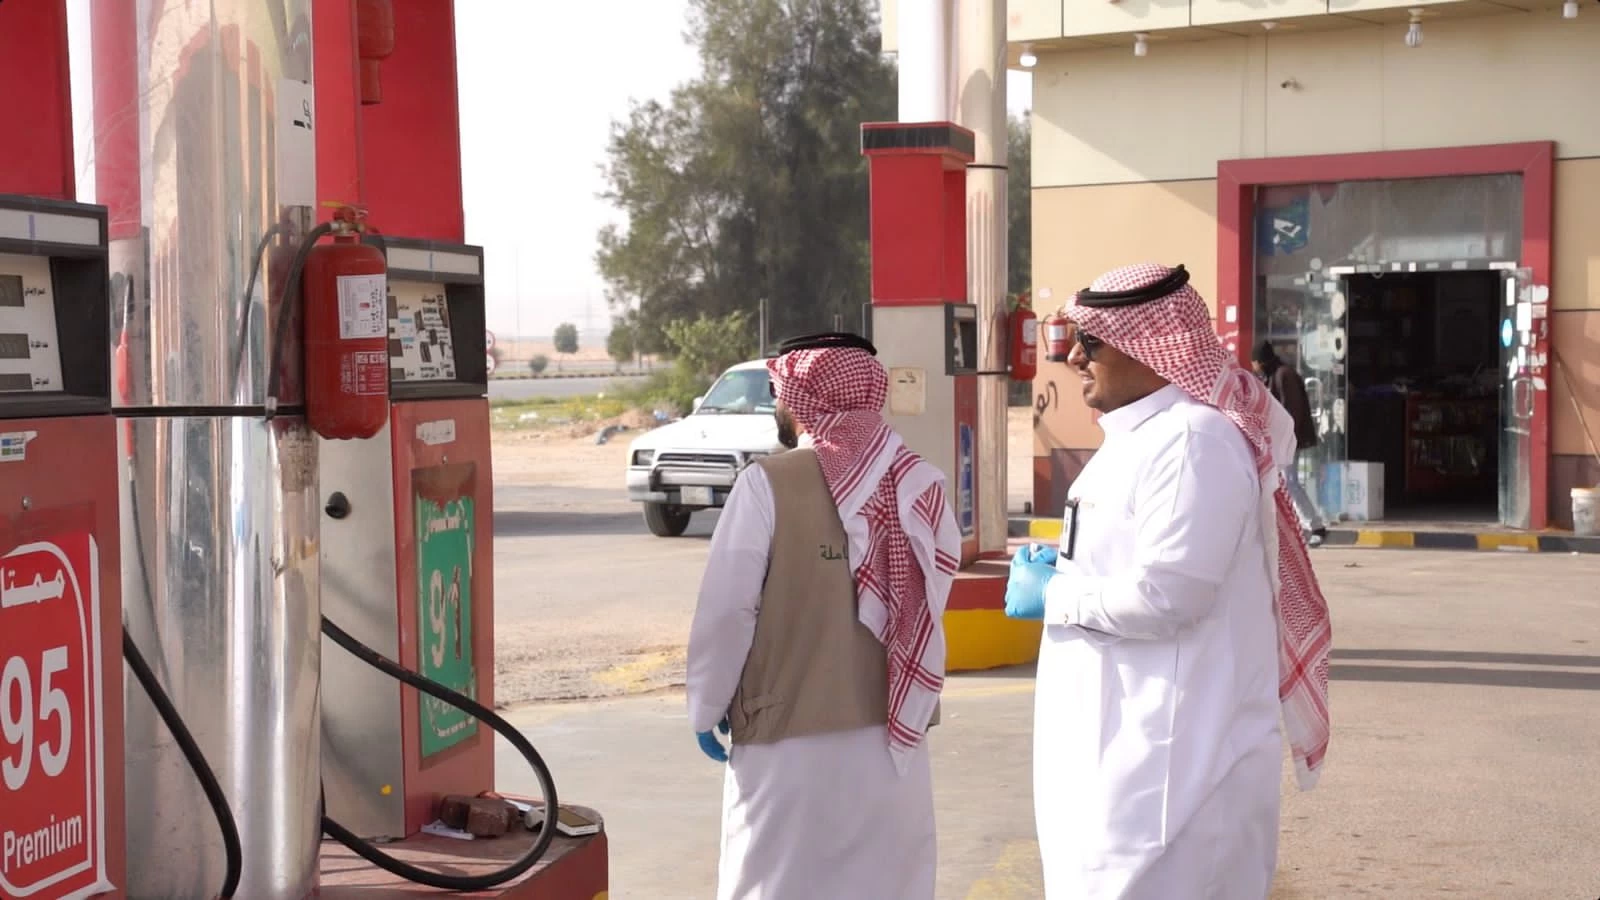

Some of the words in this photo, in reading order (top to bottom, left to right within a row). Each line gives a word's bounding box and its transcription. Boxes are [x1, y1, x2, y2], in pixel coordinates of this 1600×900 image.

[820, 544, 849, 560] املة
[0, 566, 66, 608] ممتا
[430, 565, 463, 669] 91
[0, 644, 72, 791] 95
[3, 813, 83, 873] Premium
